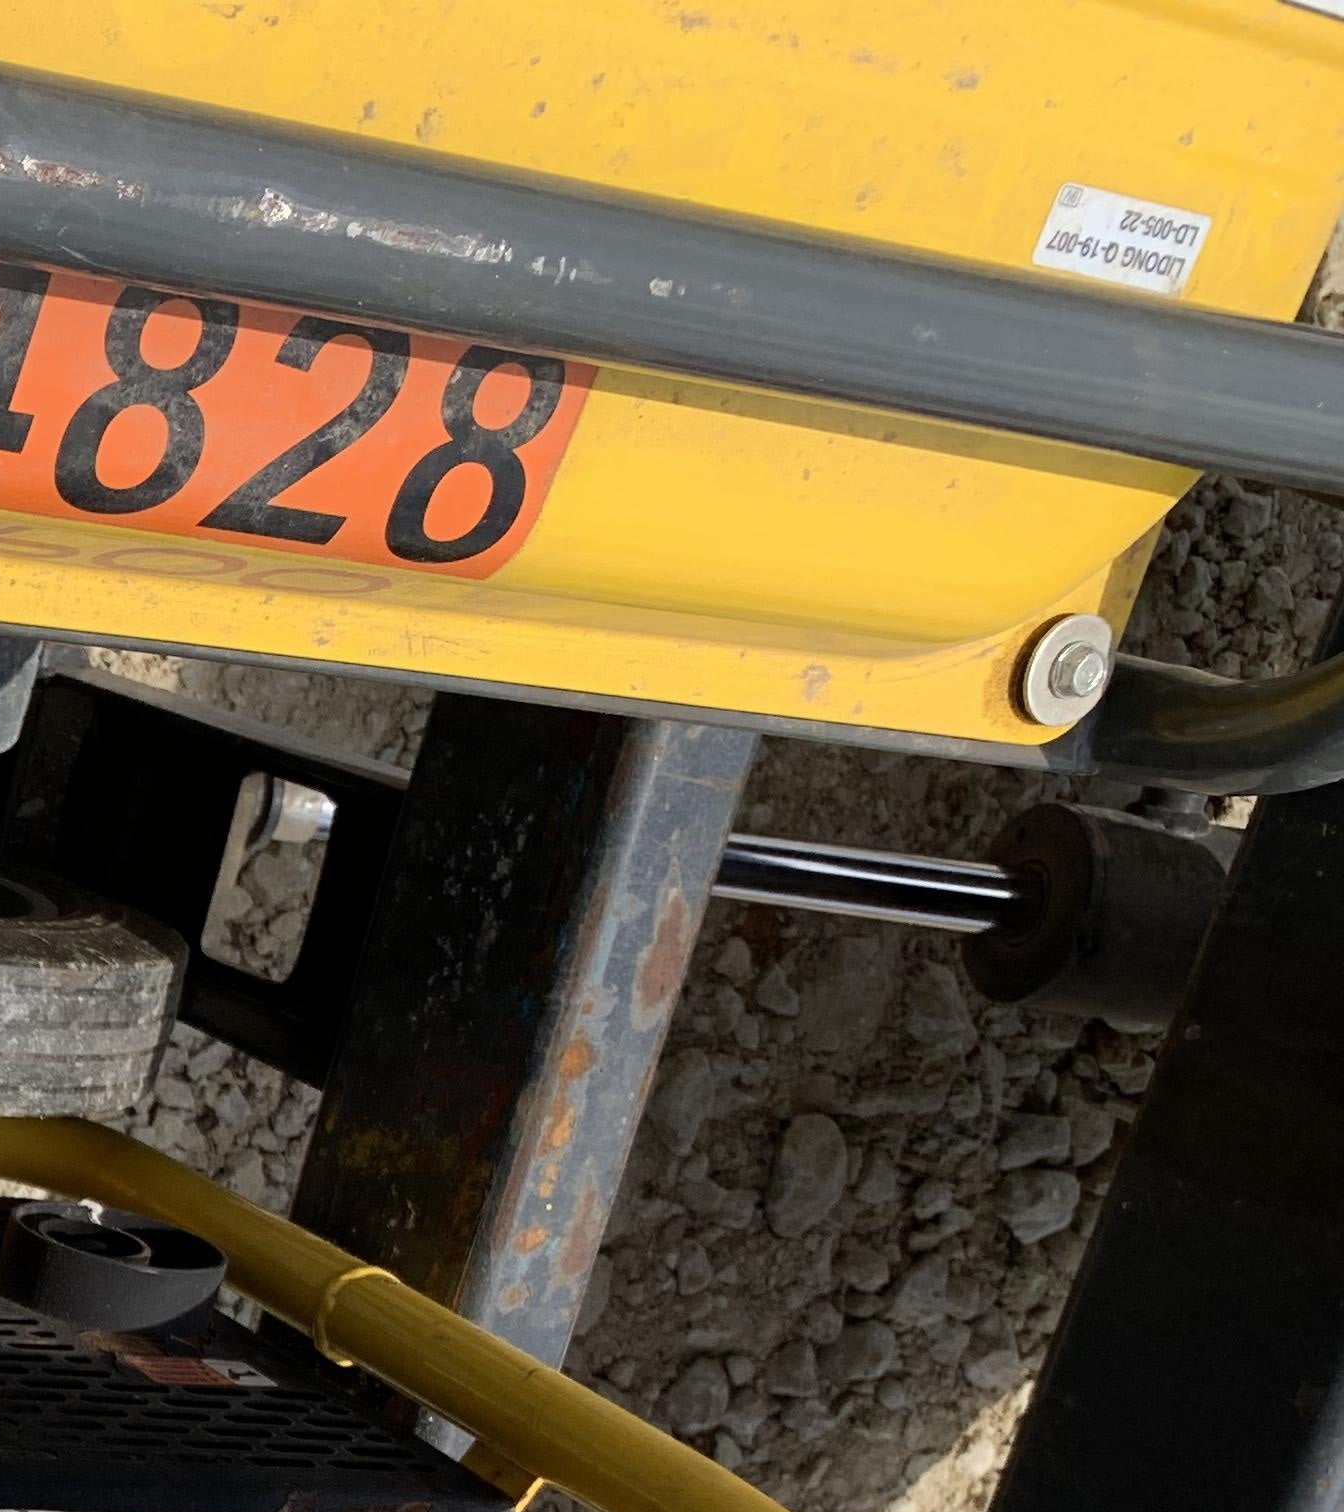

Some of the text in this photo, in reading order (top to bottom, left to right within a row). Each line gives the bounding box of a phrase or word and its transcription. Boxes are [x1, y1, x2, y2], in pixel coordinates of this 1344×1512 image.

[1118, 210, 1200, 247] LD-005-22
[1045, 229, 1188, 280] LIDONG Q-19-007
